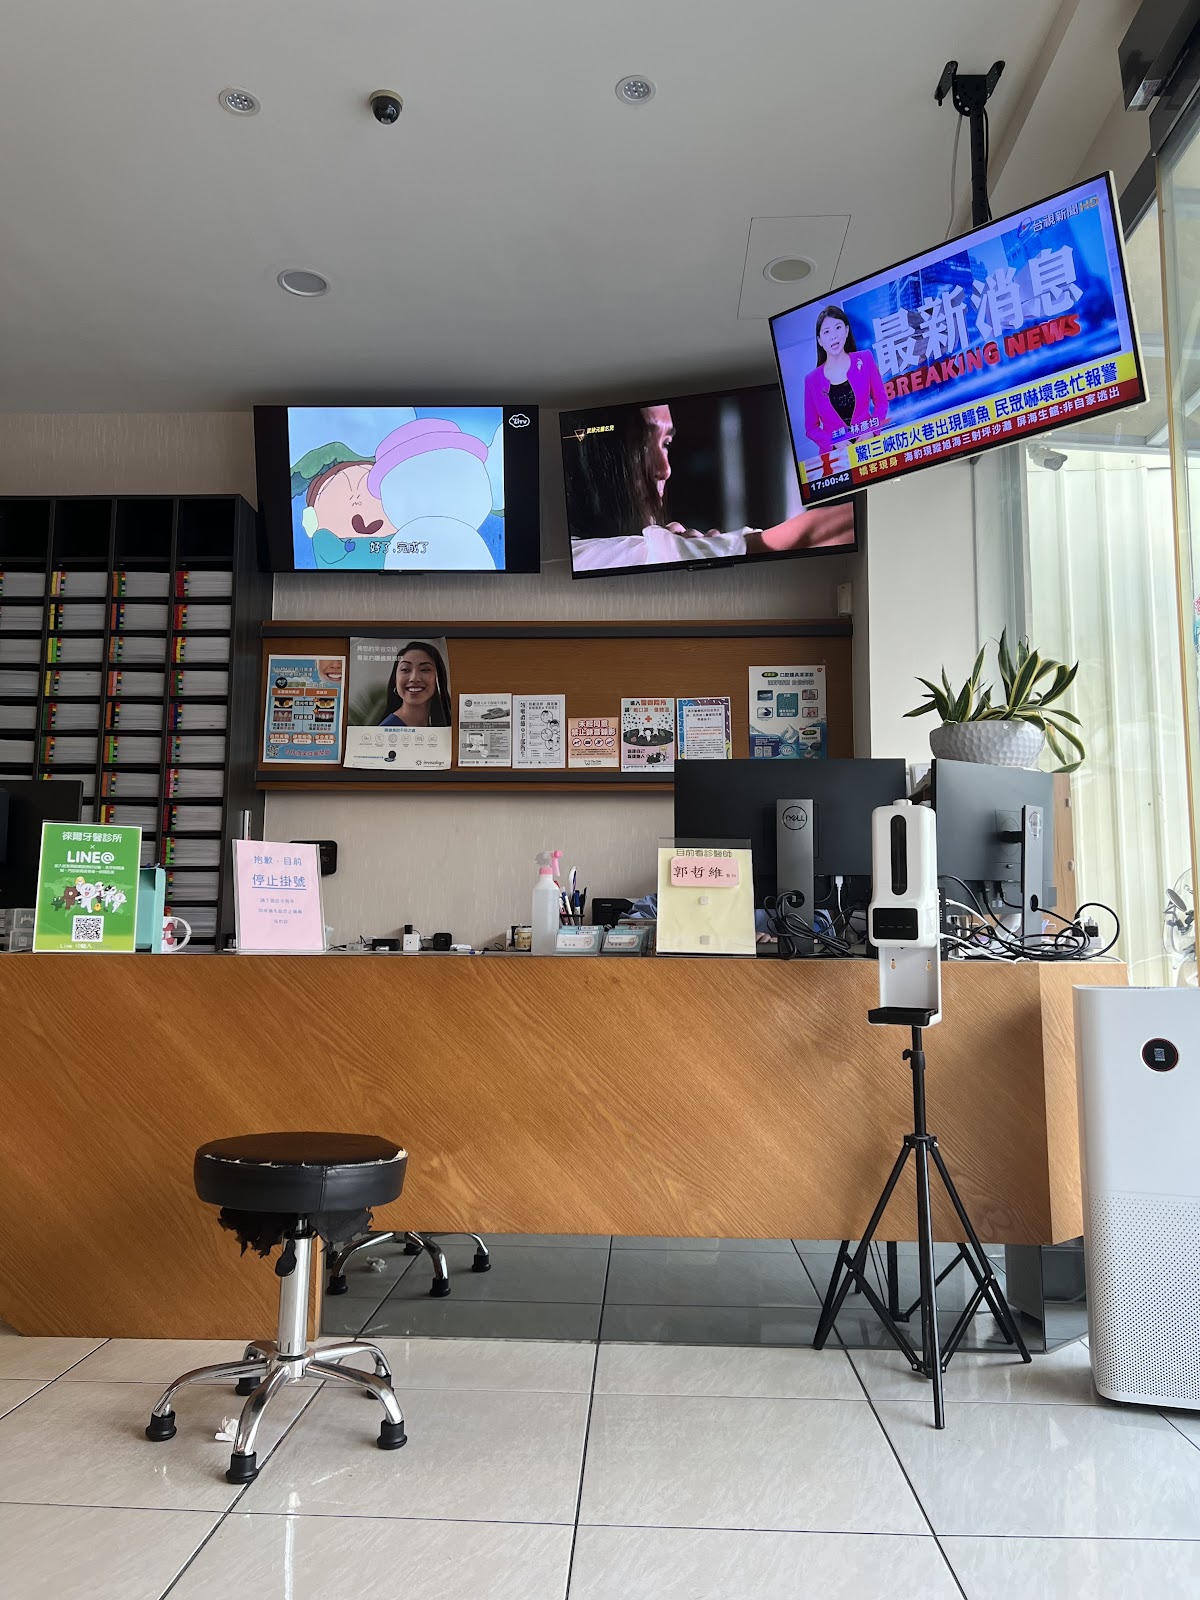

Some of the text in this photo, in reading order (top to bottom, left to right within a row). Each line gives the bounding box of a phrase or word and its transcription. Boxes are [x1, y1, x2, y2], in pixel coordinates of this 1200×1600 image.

[1033, 202, 1080, 232] 台視新聞
[872, 244, 1084, 378] 最新消息
[884, 314, 1082, 401] BREAKING NEWS
[811, 472, 850, 491] 17:00:42
[67, 850, 115, 864] LINE@
[676, 849, 732, 857] 目前看診醫師
[673, 866, 723, 878] 郭哲維
[252, 874, 306, 887] 停止掛號
